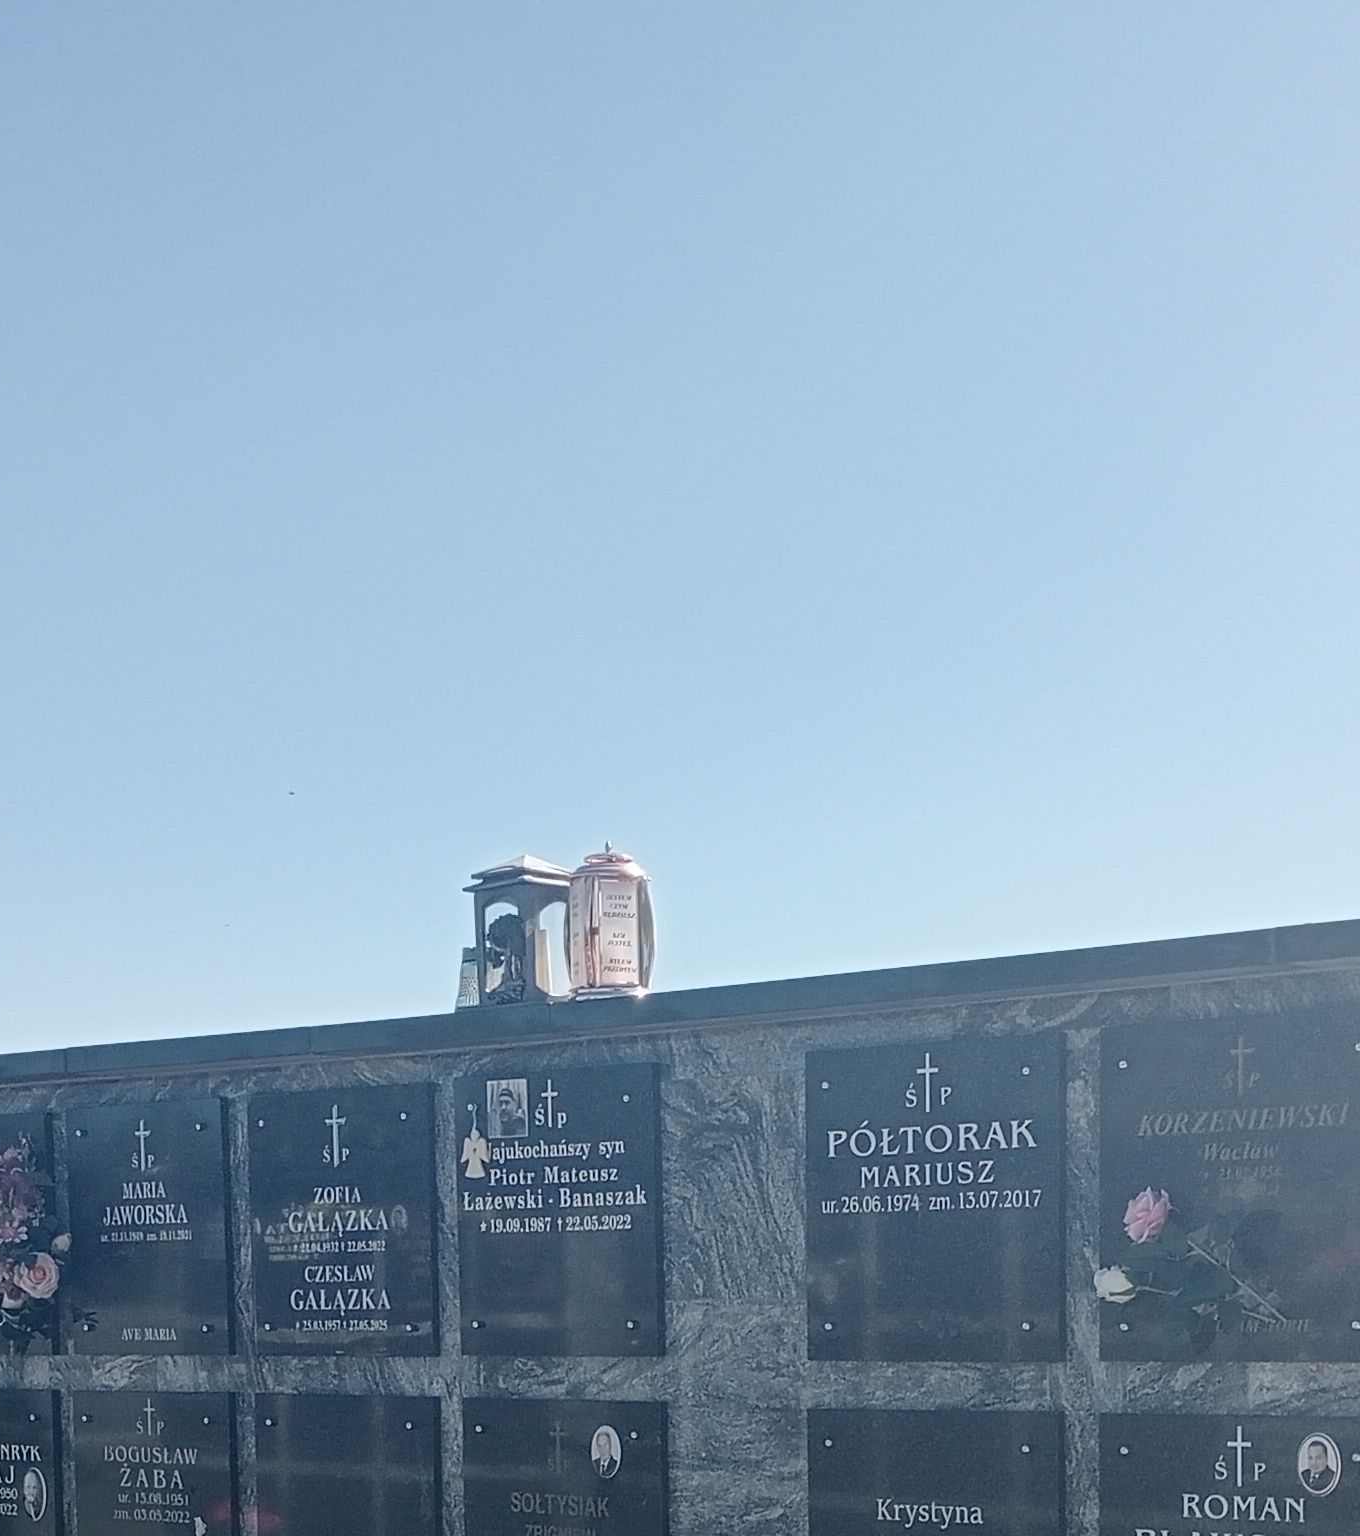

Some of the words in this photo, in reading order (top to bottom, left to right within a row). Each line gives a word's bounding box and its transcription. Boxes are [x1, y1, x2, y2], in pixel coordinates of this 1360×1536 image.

[905, 1082, 917, 1108] Ś
[940, 1087, 952, 1106] P
[1138, 1102, 1350, 1137] KORZENIEWSKI
[489, 1139, 591, 1165] ajukochańszy
[598, 1141, 625, 1160] syn
[827, 1120, 1037, 1158] PÓŁTORAK
[342, 1148, 350, 1161] P
[489, 1168, 535, 1187] Piotr
[543, 1166, 618, 1185] Mateusz
[860, 1160, 995, 1188] MARIUSZ
[122, 1181, 167, 1200] MARIA
[313, 1186, 362, 1204] ZOFIA
[463, 1189, 543, 1211] Łażewski
[559, 1184, 647, 1208] Banaszak
[821, 1200, 839, 1214] ur.
[841, 1194, 920, 1213] 26.06.1974
[928, 1195, 956, 1211] zm.
[959, 1189, 1042, 1210] 13.07.2017
[102, 1204, 189, 1226] JAWORSKA
[288, 1209, 390, 1237] GAŁĄZKA
[490, 1217, 552, 1234] 19.09.1987
[304, 1264, 376, 1282] CZESŁAW
[290, 1288, 391, 1316] GAŁĄZKA
[121, 1327, 142, 1342] AVE
[144, 1327, 177, 1342] MARIA
[157, 1421, 165, 1435] P
[104, 1445, 198, 1465] BOGUSŁAW
[1214, 1454, 1228, 1480] Ś
[1253, 1463, 1267, 1481] P
[120, 1463, 185, 1490] ŻABA
[510, 1491, 609, 1518] SOŁTYSIAK
[876, 1498, 984, 1530] Krystyna
[1182, 1494, 1305, 1523] ROMAN
